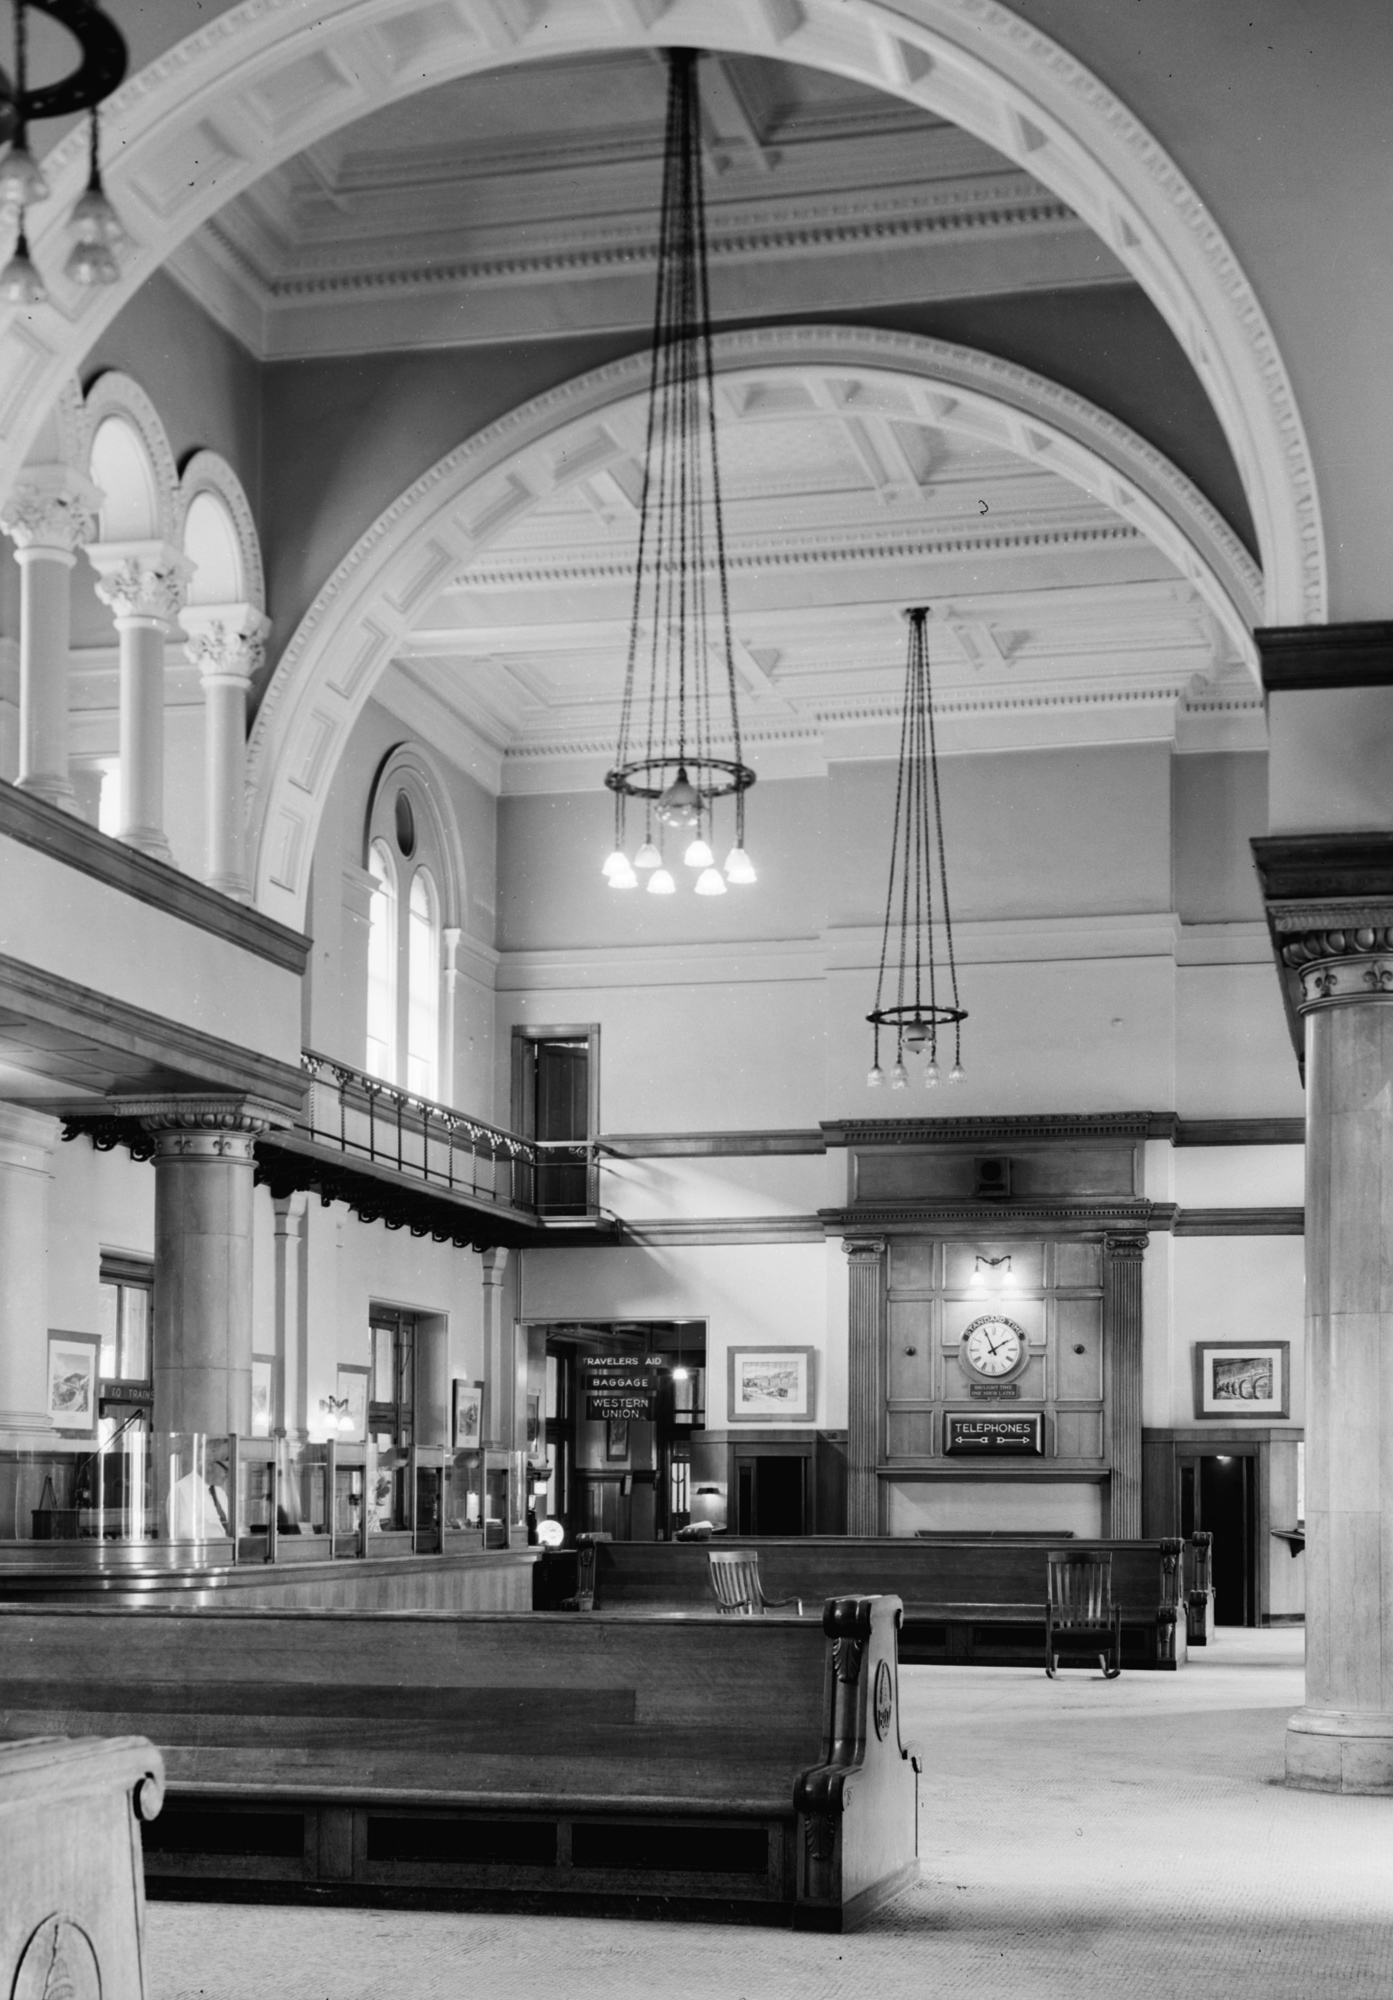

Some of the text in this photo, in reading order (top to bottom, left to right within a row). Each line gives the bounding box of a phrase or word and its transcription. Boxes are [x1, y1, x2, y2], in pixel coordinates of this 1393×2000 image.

[965, 1316, 1024, 1336] STANDARD TIME
[583, 1357, 662, 1366] TRAVELERS AID
[592, 1378, 649, 1387] BAGGAGE
[111, 1387, 122, 1398] TO
[593, 1398, 649, 1408] WESTERN
[601, 1409, 640, 1418] UNION
[954, 1423, 1031, 1433] TELEPHONES
